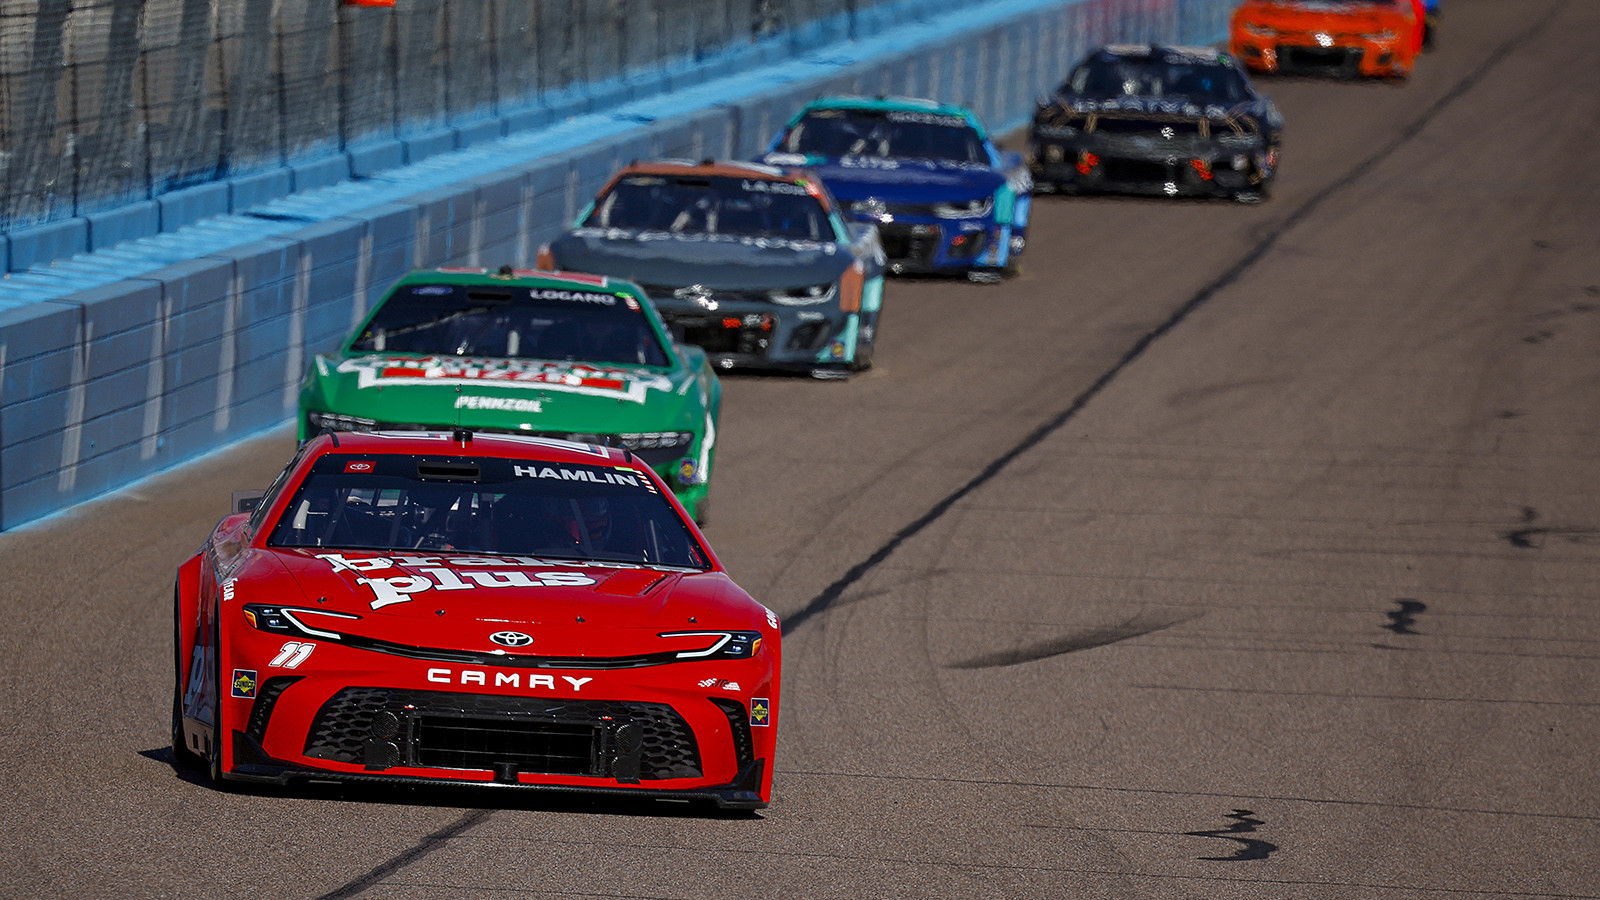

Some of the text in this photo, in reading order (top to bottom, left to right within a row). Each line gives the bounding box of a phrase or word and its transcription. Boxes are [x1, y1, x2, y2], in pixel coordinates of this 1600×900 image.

[529, 289, 616, 306] LOGANO
[454, 395, 543, 413] PENNZOIL
[513, 465, 639, 487] HAMLIN
[356, 567, 598, 611] plus
[268, 641, 317, 669] 11
[427, 668, 593, 692] CAMRY
